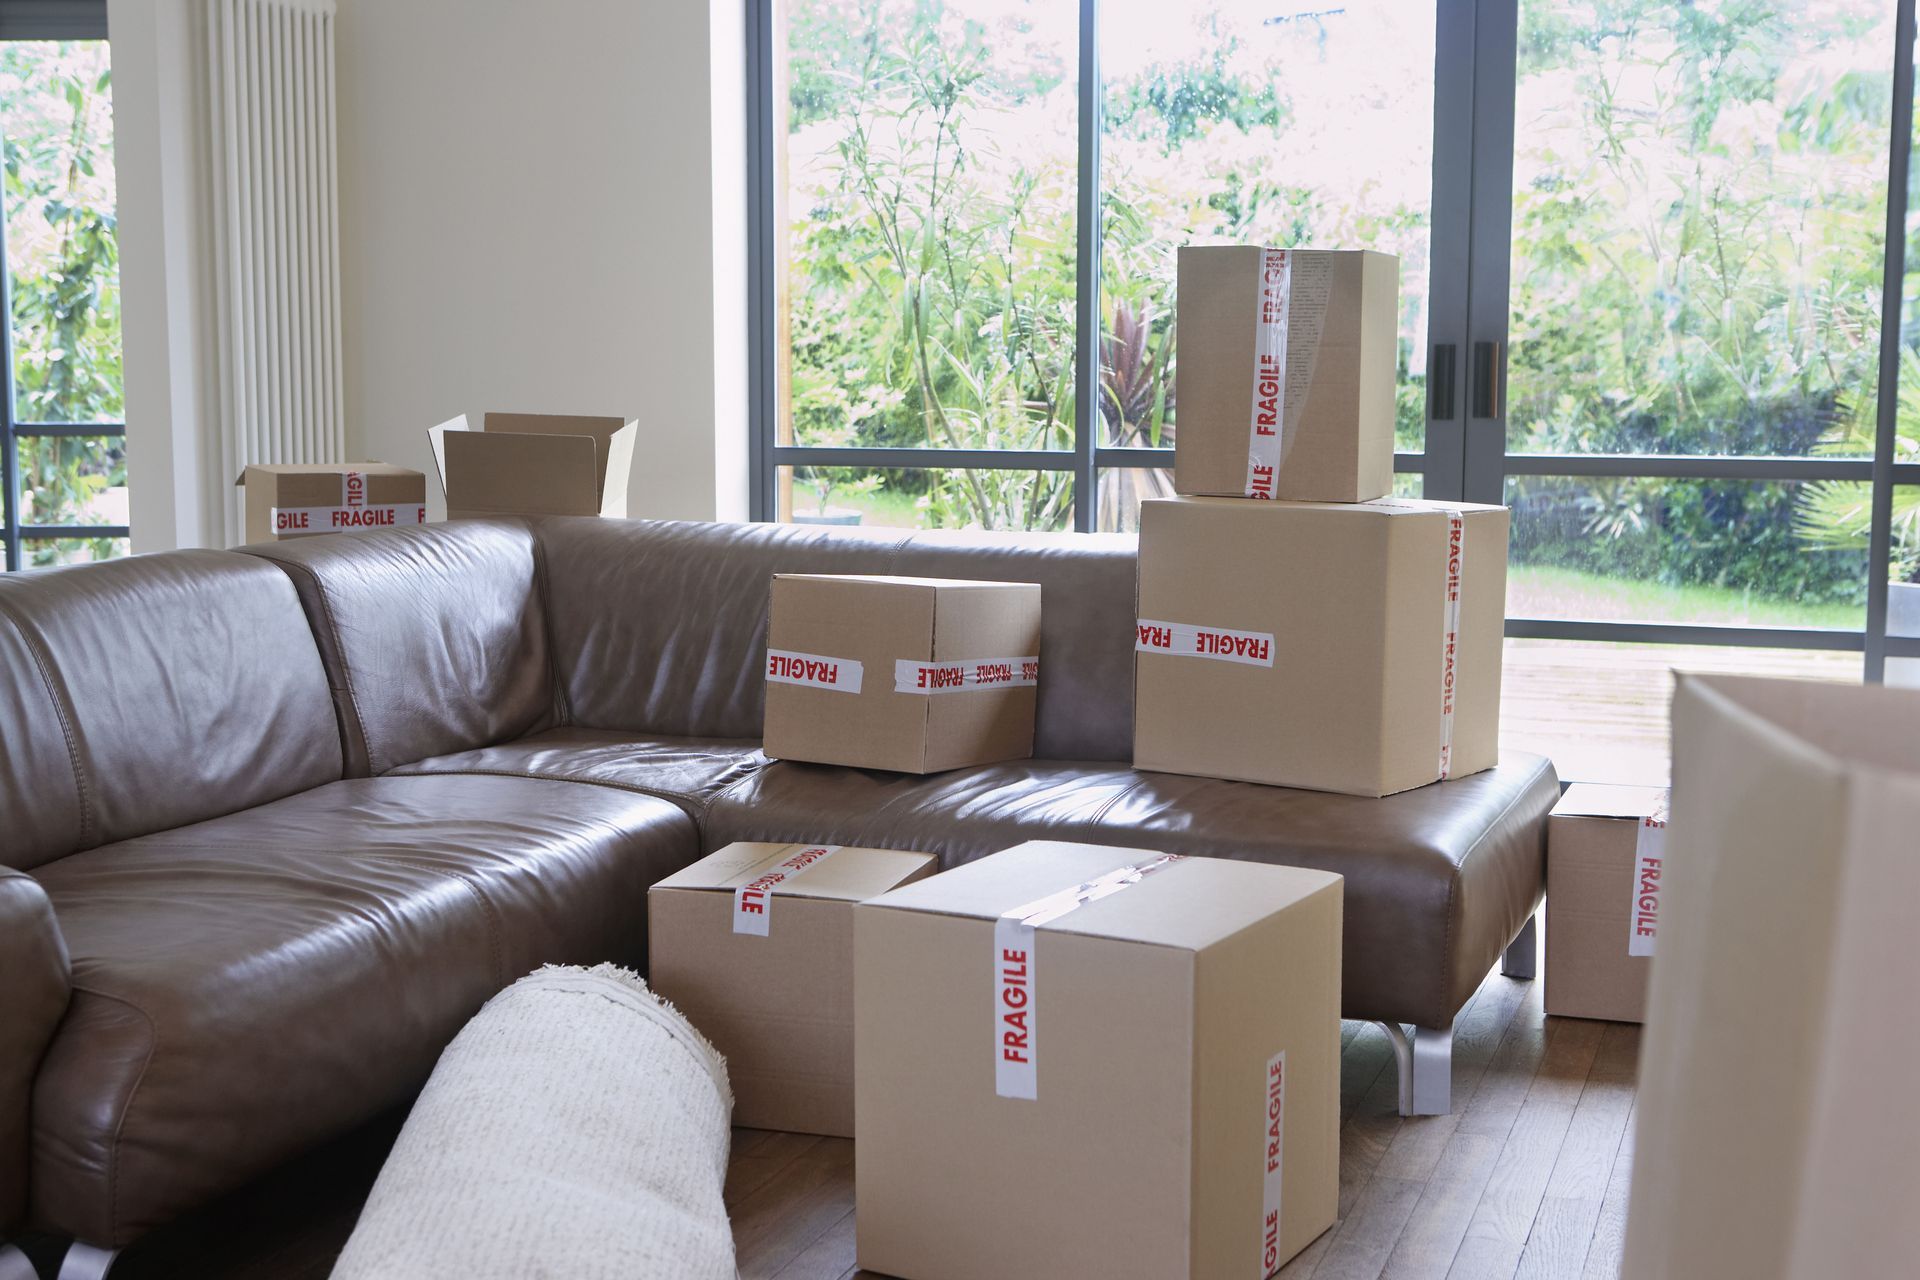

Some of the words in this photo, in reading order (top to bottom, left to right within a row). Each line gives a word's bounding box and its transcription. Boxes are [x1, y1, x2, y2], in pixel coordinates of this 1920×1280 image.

[1257, 355, 1280, 436] FRAGILE
[277, 512, 309, 529] GILE
[332, 509, 395, 527] FRAGILE
[1447, 519, 1462, 601] FRAGILE
[1136, 625, 1171, 648] FRA
[1196, 632, 1269, 660] FRAGILE
[769, 655, 838, 684] FRAGILE
[917, 667, 964, 688] FRAGILE
[976, 664, 1012, 684] FRAGILE
[1443, 632, 1456, 715] FRAGILE
[1637, 858, 1663, 937] FRAGILE
[1003, 949, 1029, 1063] FRAGILE
[1267, 1061, 1282, 1173] FRAGILE
